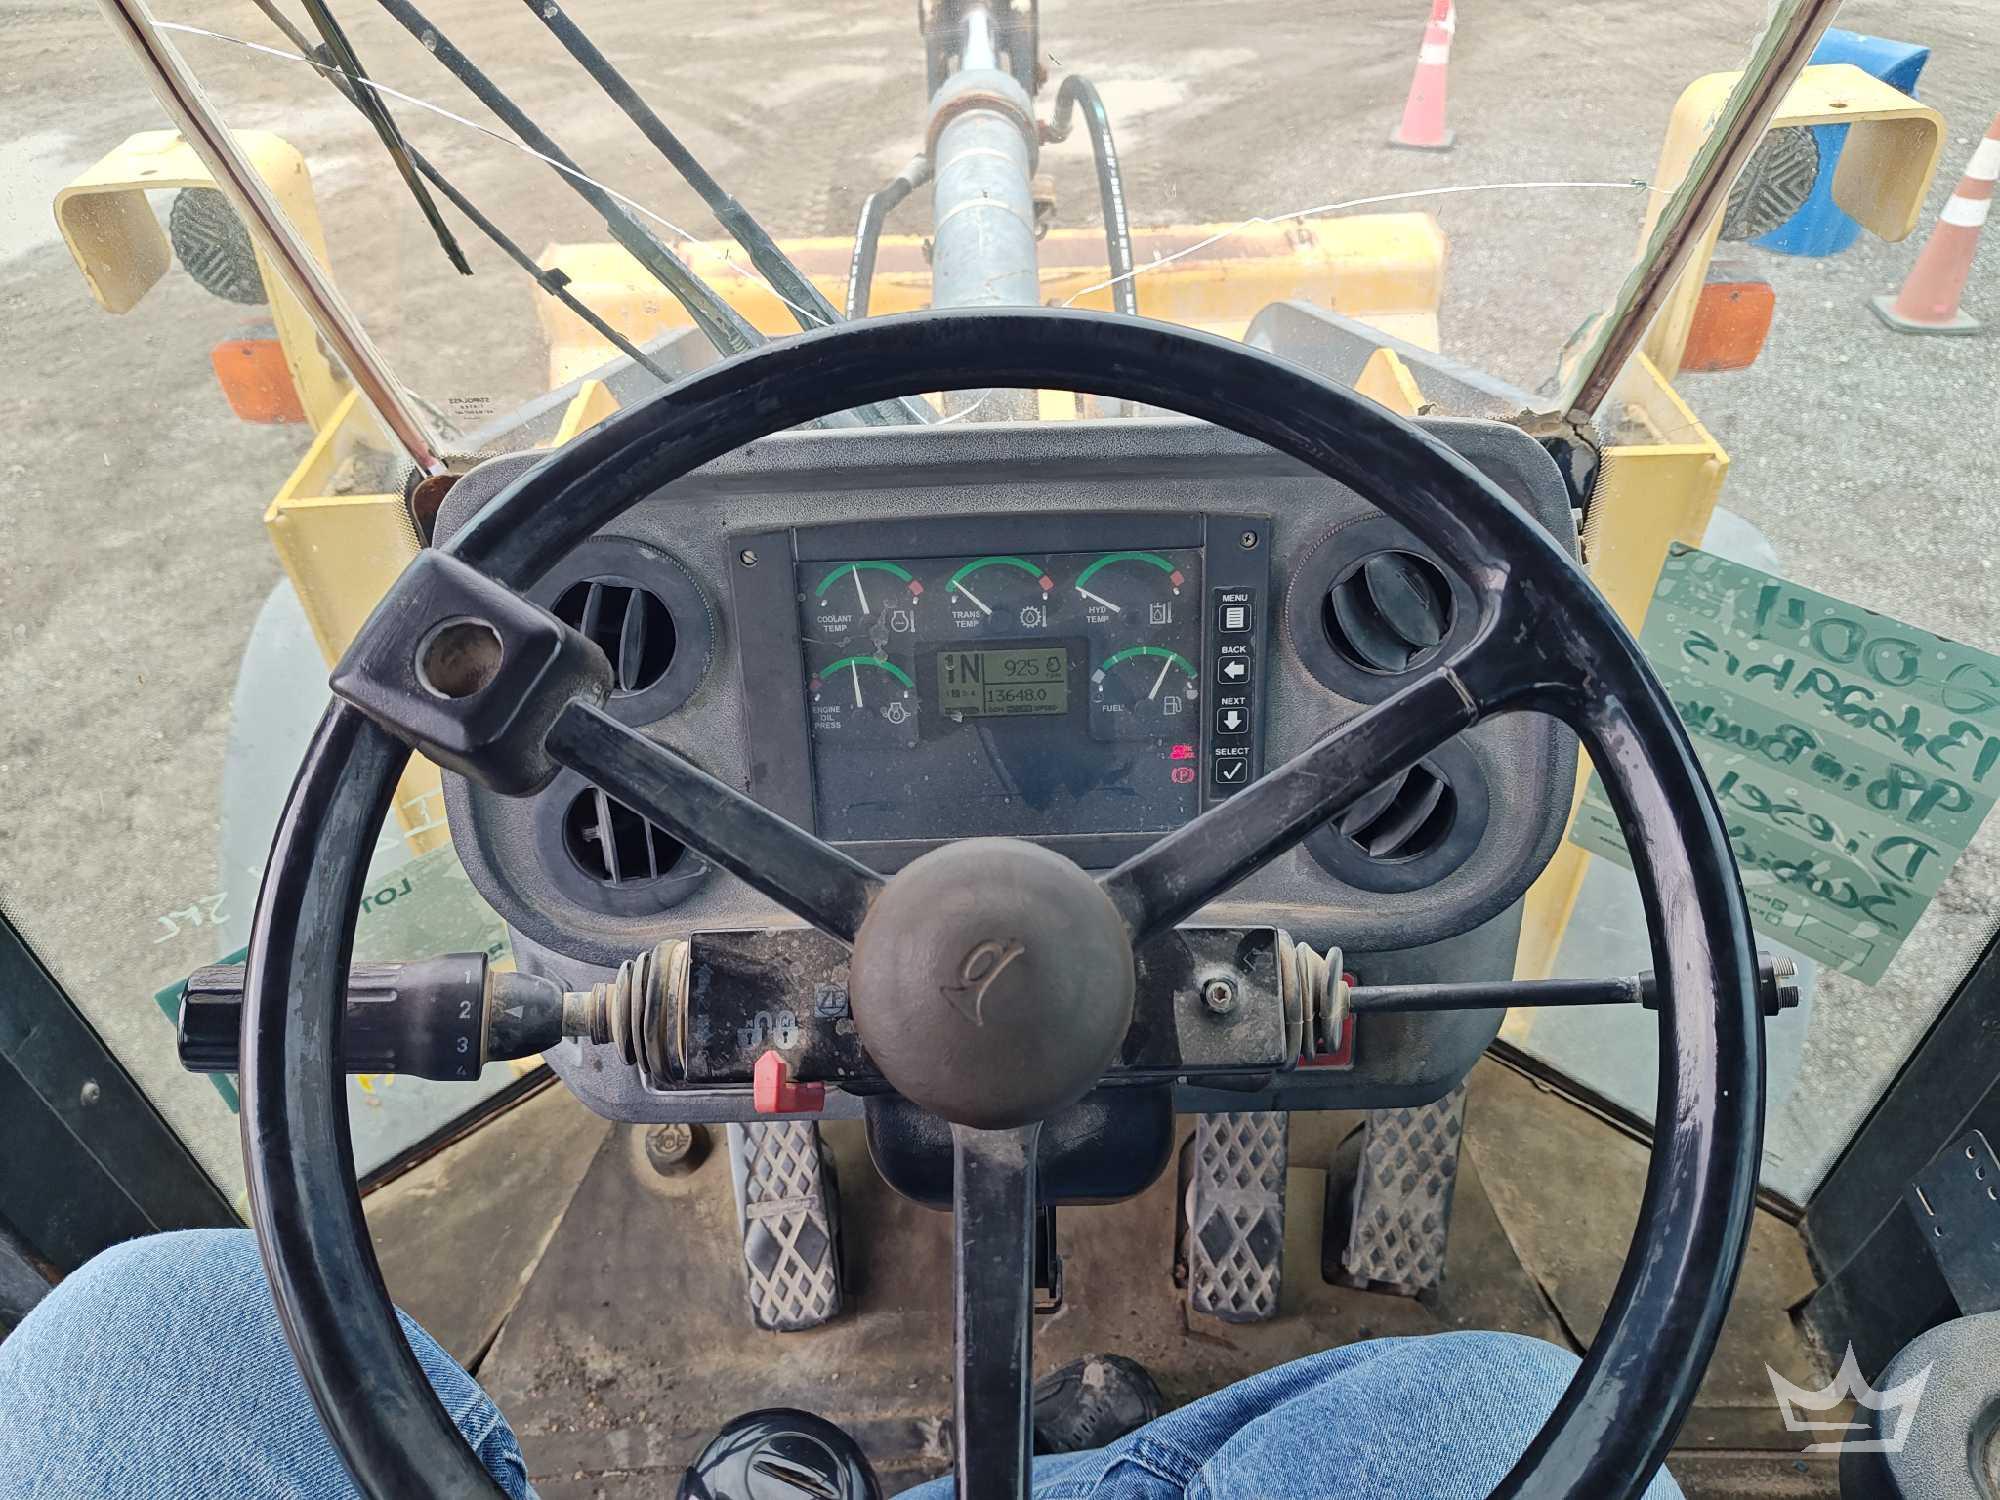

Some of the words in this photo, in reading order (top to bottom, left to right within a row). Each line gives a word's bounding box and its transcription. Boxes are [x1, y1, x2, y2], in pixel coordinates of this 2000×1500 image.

[1088, 606, 1107, 614] HYD
[817, 615, 852, 623] COOLANT
[952, 611, 981, 619] TRANS
[1086, 615, 1109, 624] TEMP
[955, 620, 979, 628] TEMP
[1221, 646, 1246, 654] BACK
[1004, 659, 1040, 677] 925
[1215, 747, 1250, 756] SELECT
[464, 969, 472, 984] 1
[459, 1000, 472, 1019] 2
[457, 1036, 469, 1053] 3
